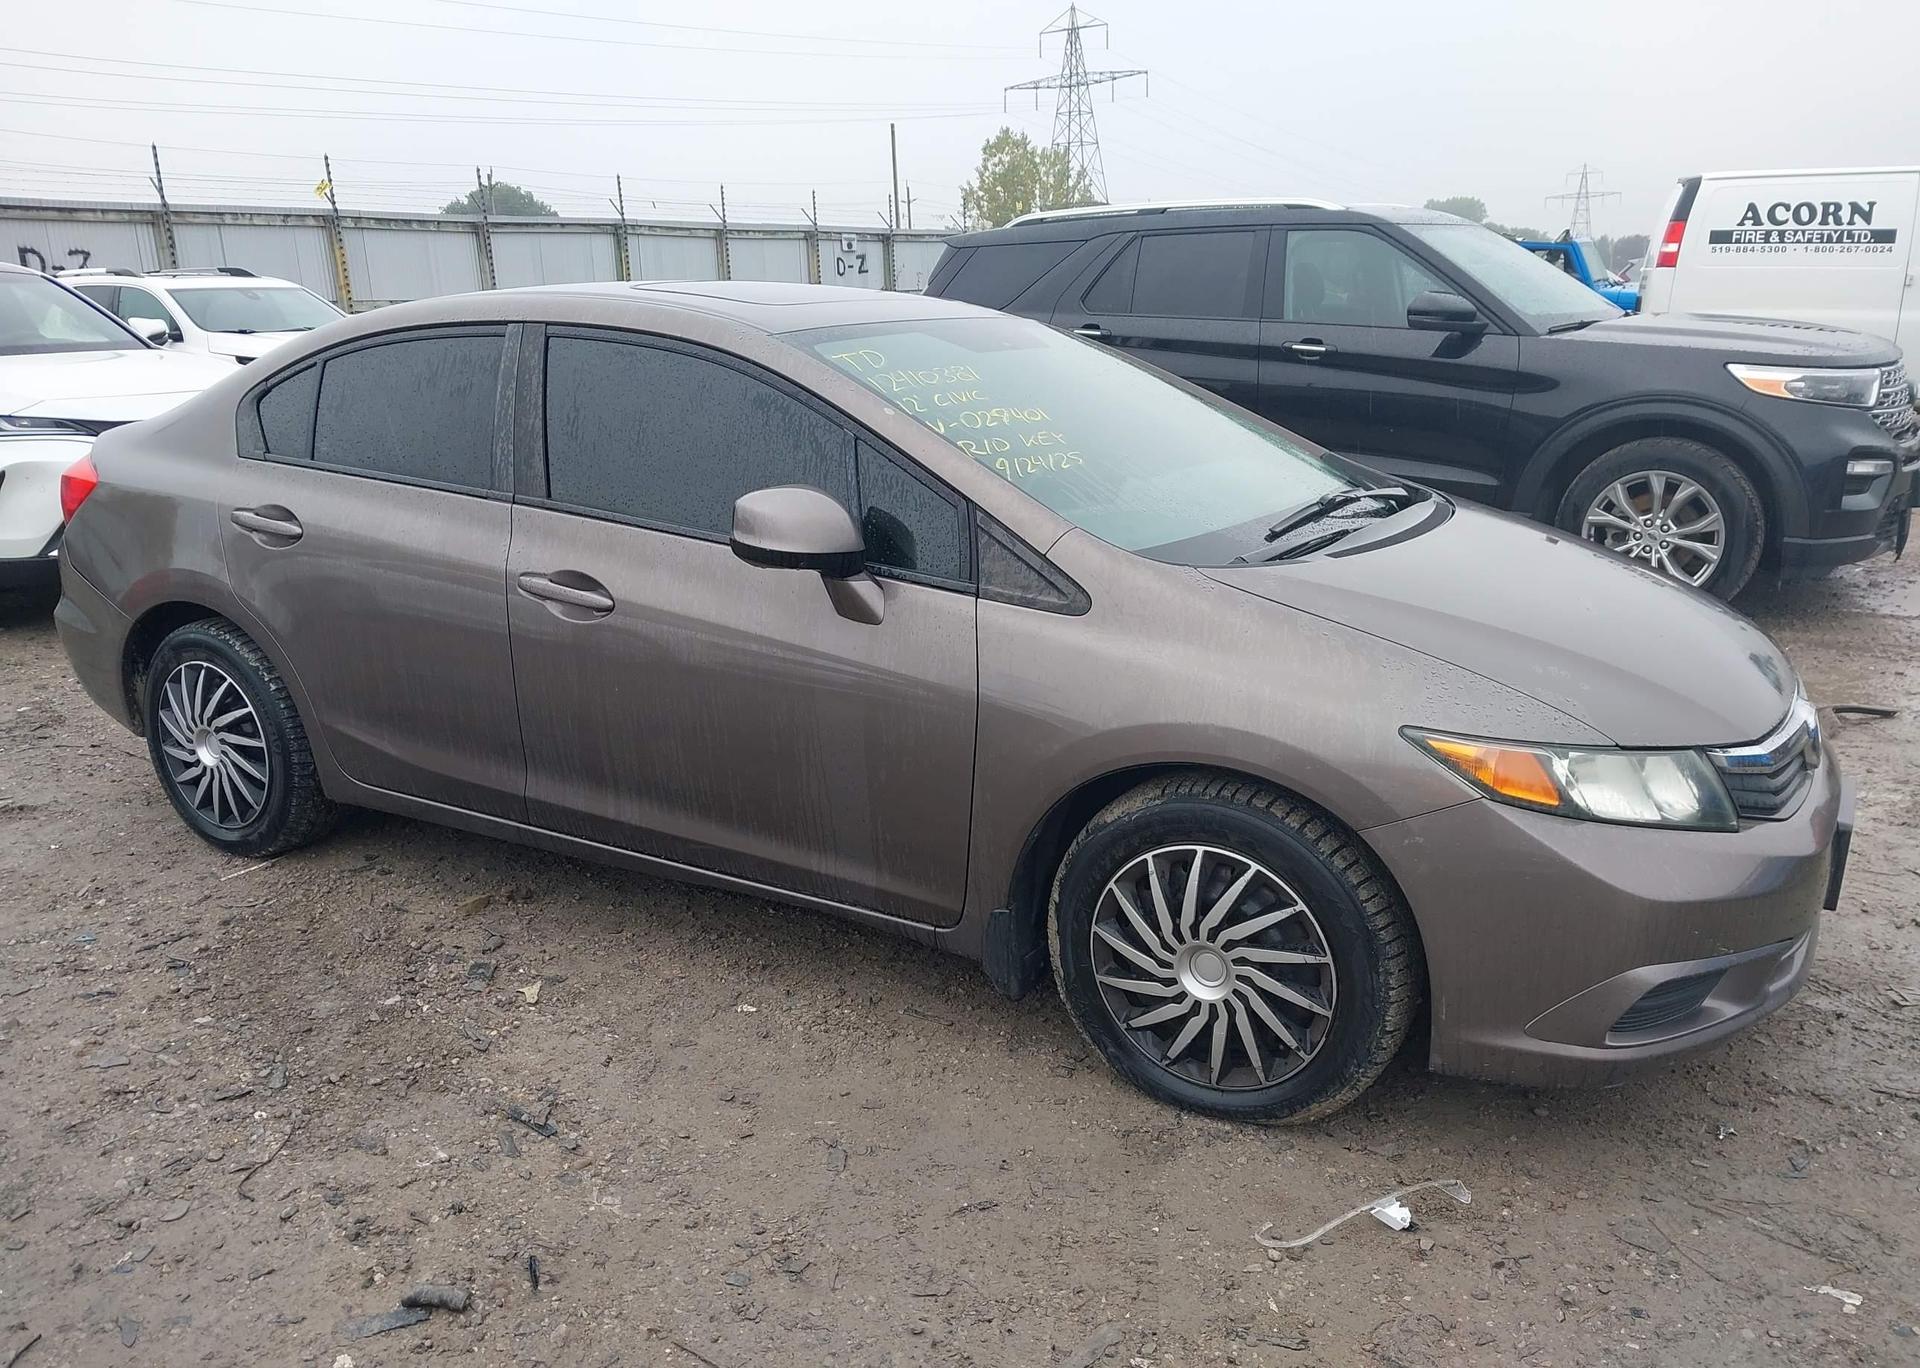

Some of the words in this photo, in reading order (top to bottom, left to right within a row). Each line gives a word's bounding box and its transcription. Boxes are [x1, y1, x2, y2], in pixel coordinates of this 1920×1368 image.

[1736, 201, 1877, 226] ACORN
[1732, 231, 1766, 243] FIRE
[1769, 231, 1780, 243] &
[1784, 230, 1841, 243] SAFETY
[1842, 230, 1875, 243] LTD.
[1711, 245, 1787, 254] 519-884-5300
[1803, 245, 1893, 253] 1-800-267-0024
[832, 349, 886, 372] TD
[934, 389, 989, 407] CIVIC
[1019, 431, 1068, 448] KEY
[995, 451, 1083, 481] 9/24/25
